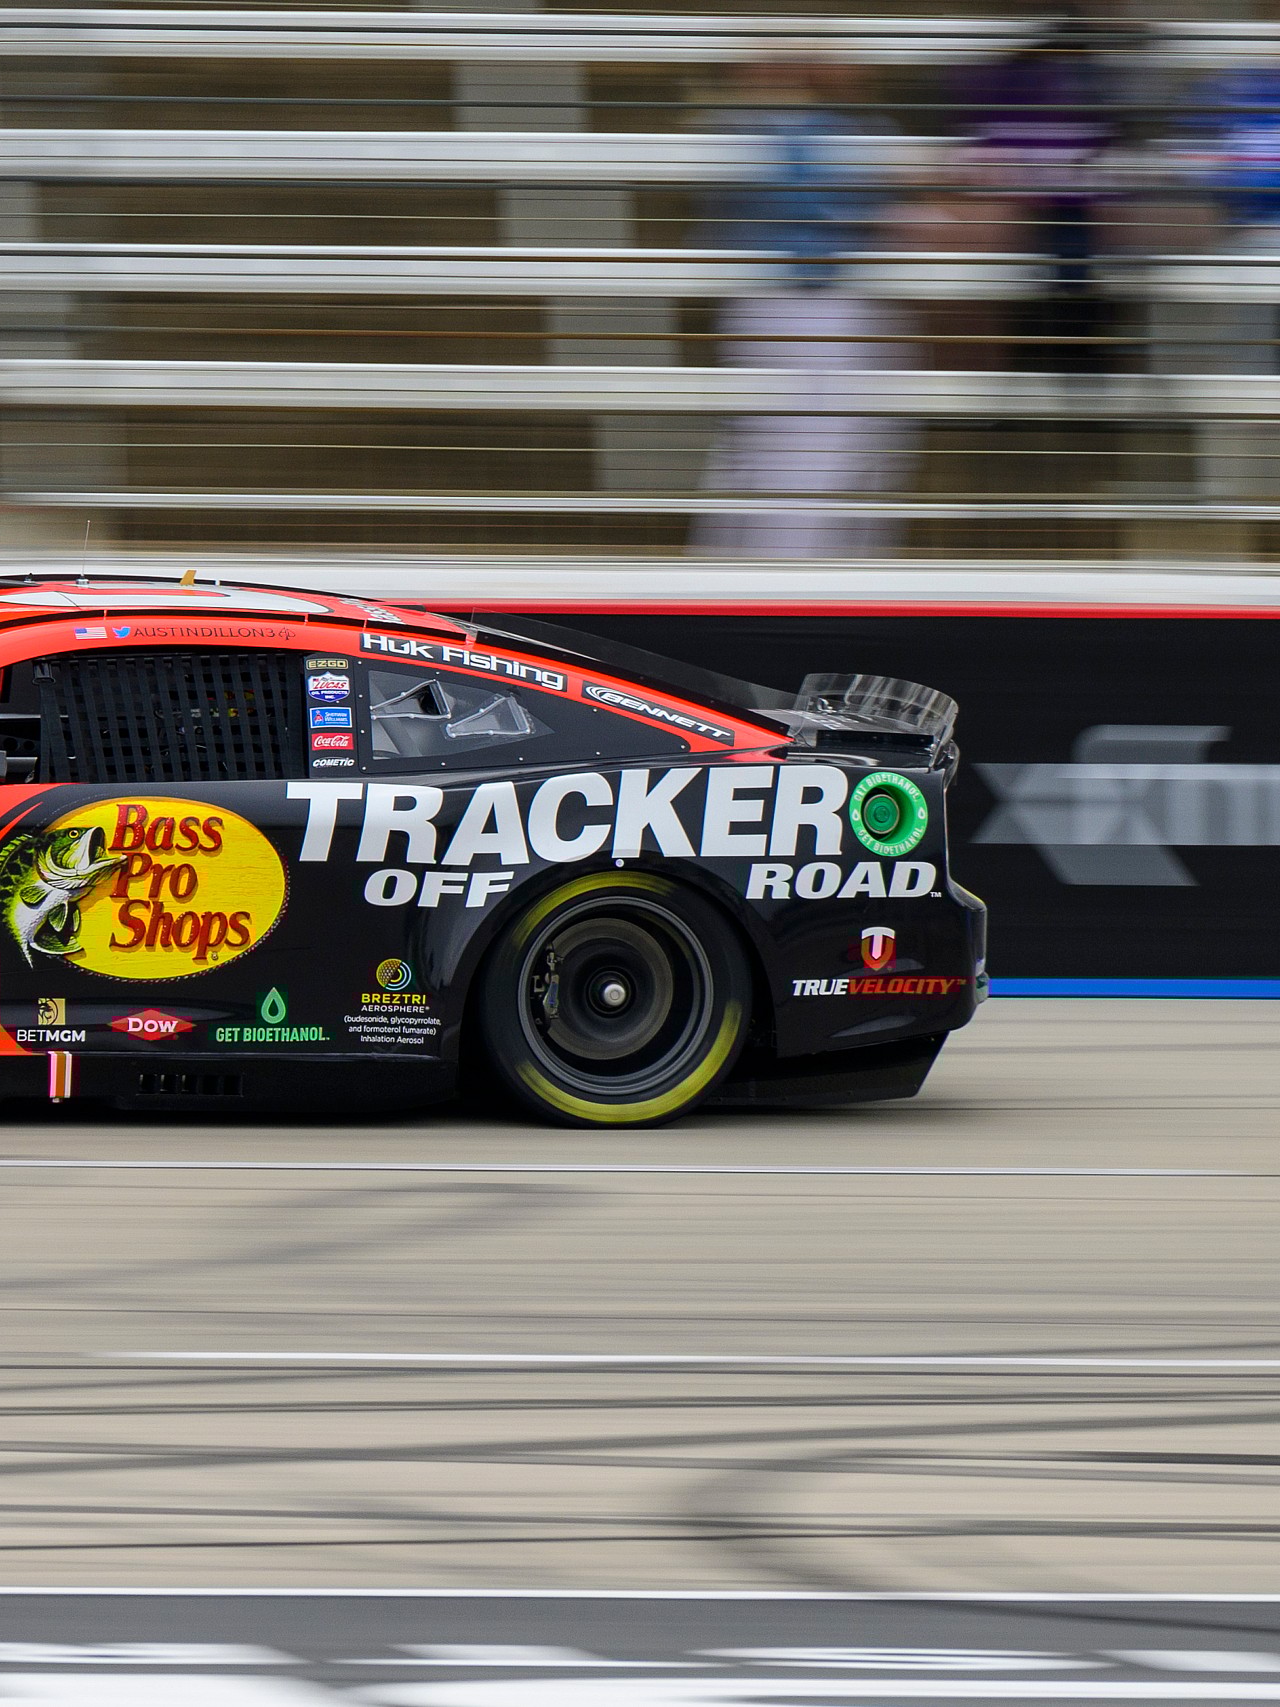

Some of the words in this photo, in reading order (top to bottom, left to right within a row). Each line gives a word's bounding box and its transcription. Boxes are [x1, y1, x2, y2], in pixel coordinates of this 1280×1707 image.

[133, 627, 276, 638] AUSTINDILLON3
[313, 681, 347, 690] LUCAS
[602, 691, 731, 739] BENNETT
[286, 765, 849, 866] TRACKER
[108, 804, 224, 852] Bass
[109, 852, 199, 899] Pro
[364, 869, 515, 908] OFF
[745, 861, 937, 899] ROAD
[109, 899, 251, 961] Shops
[361, 993, 426, 1004] BREZTRI
[343, 1015, 389, 1024] (budesonide,
[215, 1027, 240, 1042] GET
[348, 1025, 362, 1033] and
[363, 1025, 401, 1033] formoterol
[402, 1026, 437, 1035] fumarate)
[360, 1035, 395, 1043] Inhalation
[396, 1036, 424, 1044] Aerosol
